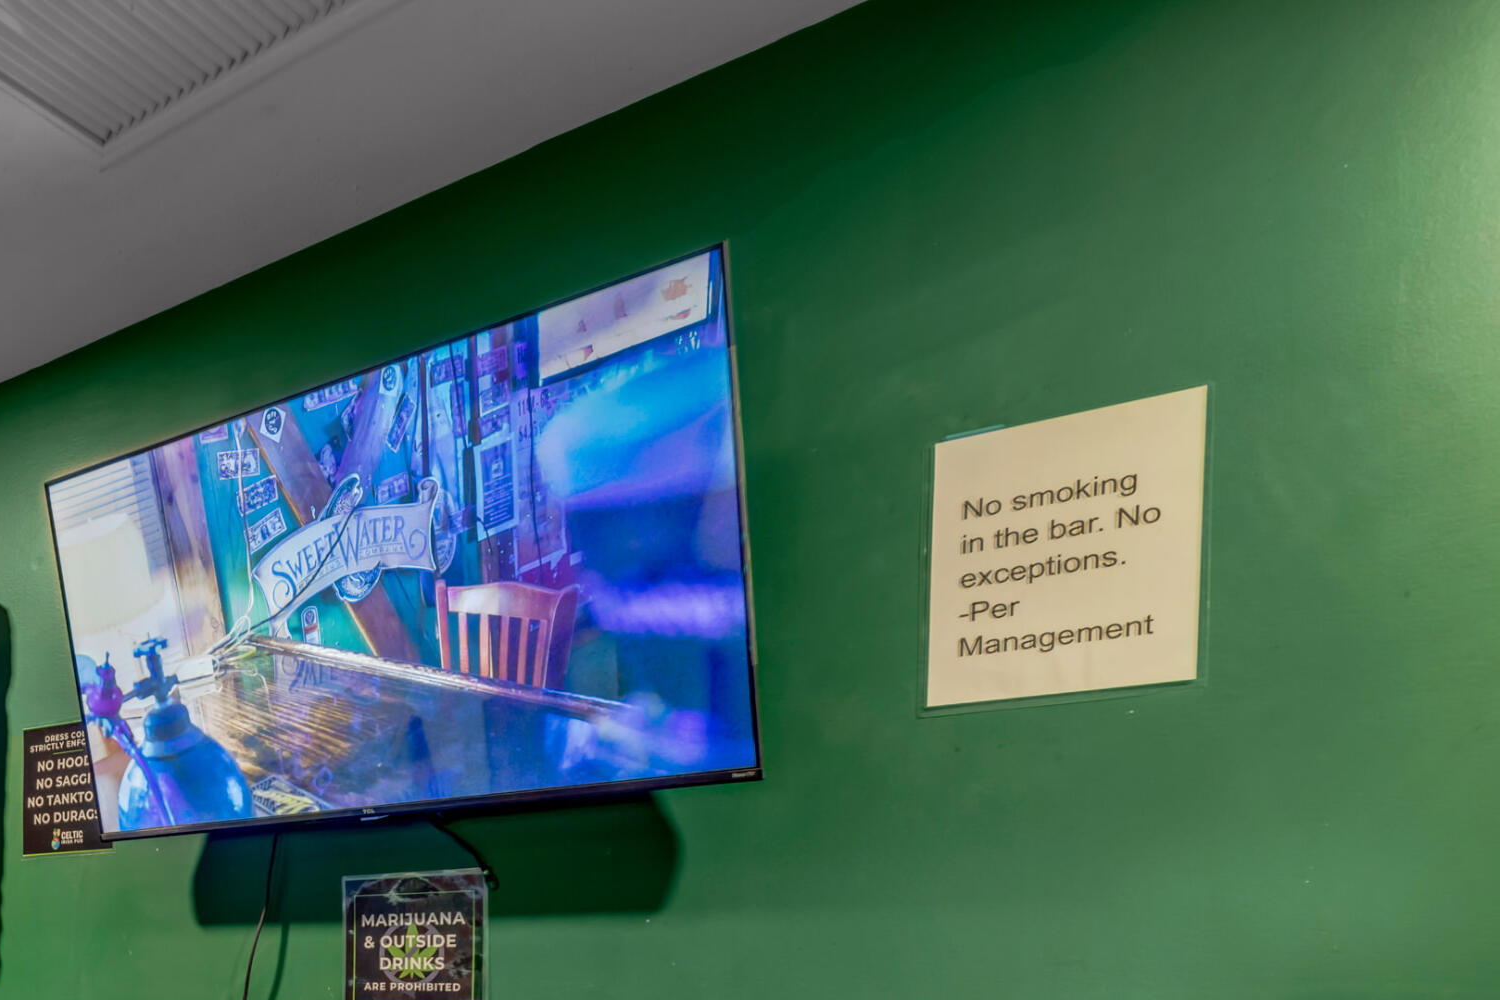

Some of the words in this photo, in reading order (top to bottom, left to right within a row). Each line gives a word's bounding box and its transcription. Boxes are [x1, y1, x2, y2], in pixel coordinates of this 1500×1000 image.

[962, 498, 1002, 520] No
[1011, 473, 1138, 511] smoking
[960, 534, 984, 554] in
[994, 527, 1038, 550] the
[1050, 516, 1104, 540] bar.
[1116, 504, 1161, 529] No
[959, 550, 1127, 589] exceptions.
[958, 600, 1020, 622] -Per
[958, 614, 1155, 657] Management
[44, 732, 69, 743] DRESS
[30, 741, 65, 753] STRICTLY
[37, 760, 54, 772] NO
[57, 754, 89, 770] HOOD
[36, 778, 53, 790] NO
[55, 772, 91, 787] SAGGI
[27, 796, 44, 808] NO
[46, 790, 94, 806] TANKTO
[33, 812, 50, 825] NO
[61, 829, 84, 840] CELTIC
[361, 911, 466, 928] MARIJUANA
[363, 935, 376, 949] &
[380, 934, 457, 948] OUTSIDE
[379, 956, 445, 970] DRINKS
[363, 982, 386, 991] ARE
[390, 982, 461, 992] PROHIBITED
